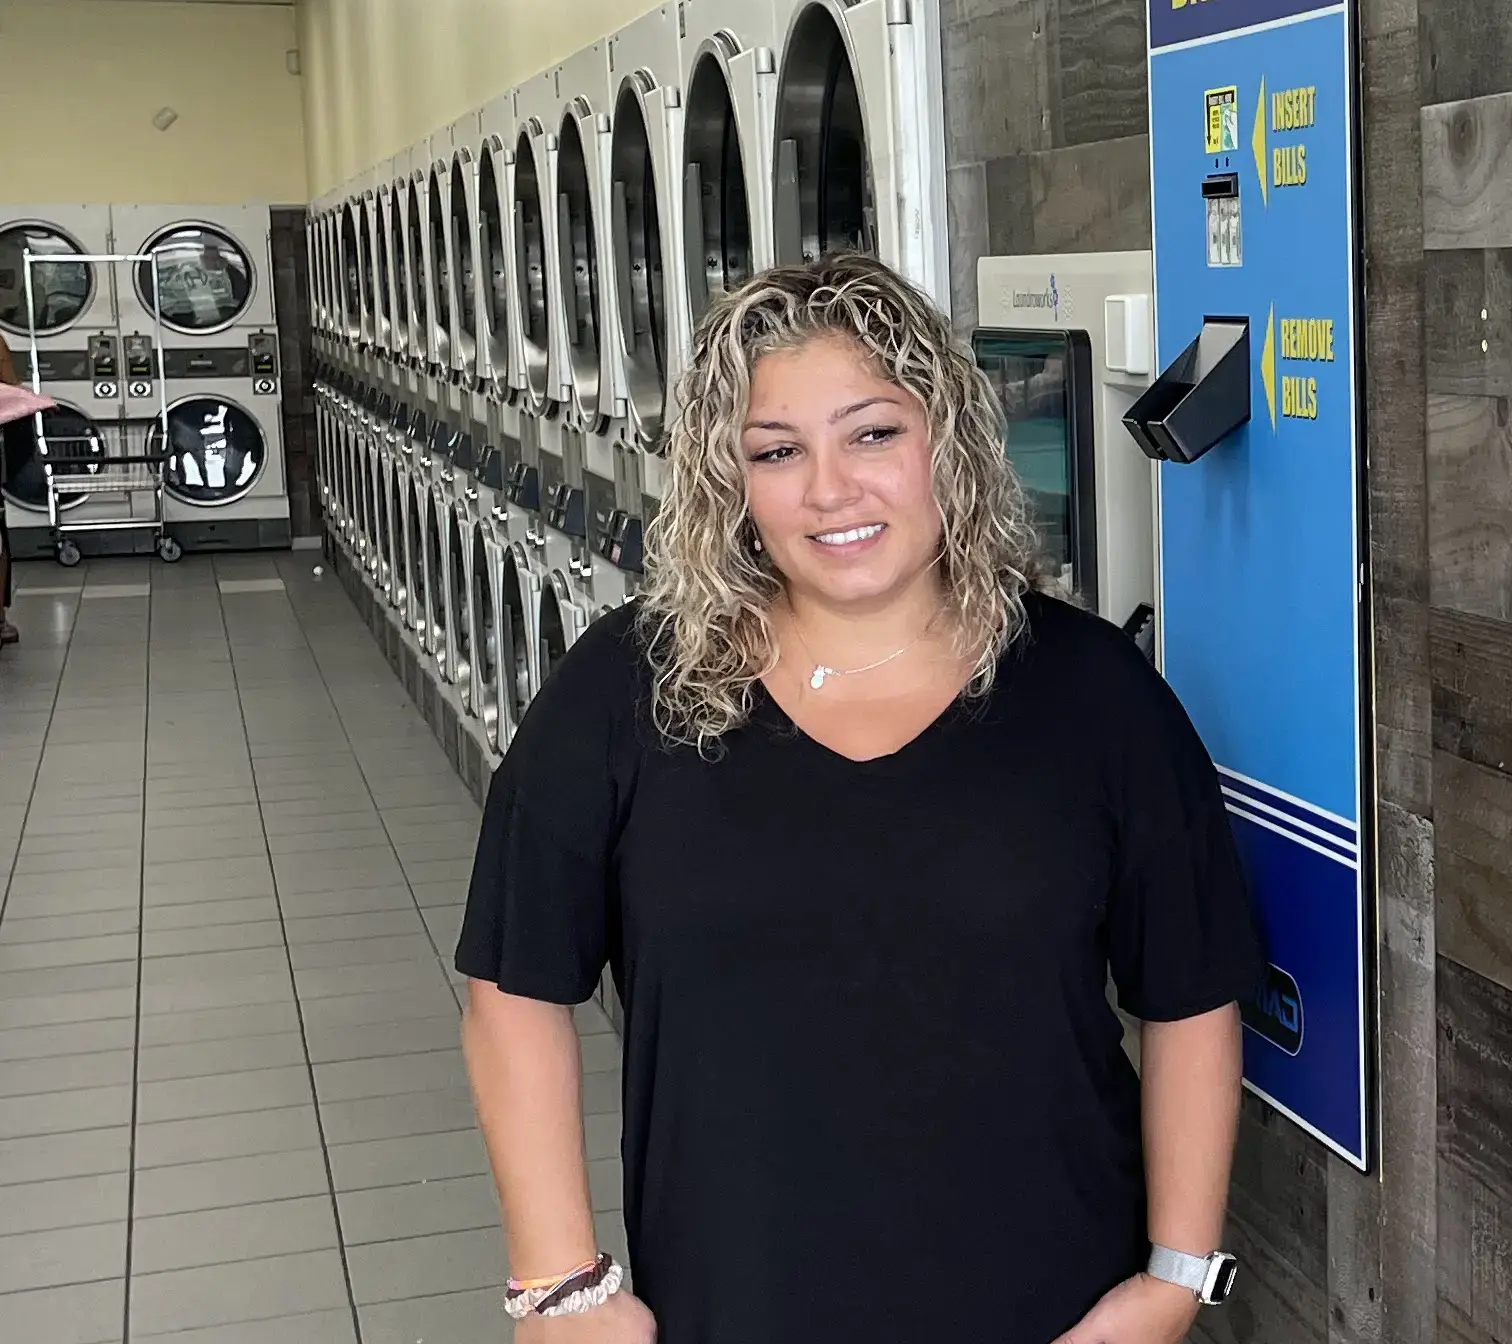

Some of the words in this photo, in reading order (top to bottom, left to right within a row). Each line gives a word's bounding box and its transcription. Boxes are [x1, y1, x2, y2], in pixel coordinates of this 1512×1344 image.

[1272, 85, 1316, 132] INSERT
[1272, 144, 1307, 188] BILLS
[1280, 318, 1335, 362] REMOVE
[1281, 376, 1319, 420] BILLS
